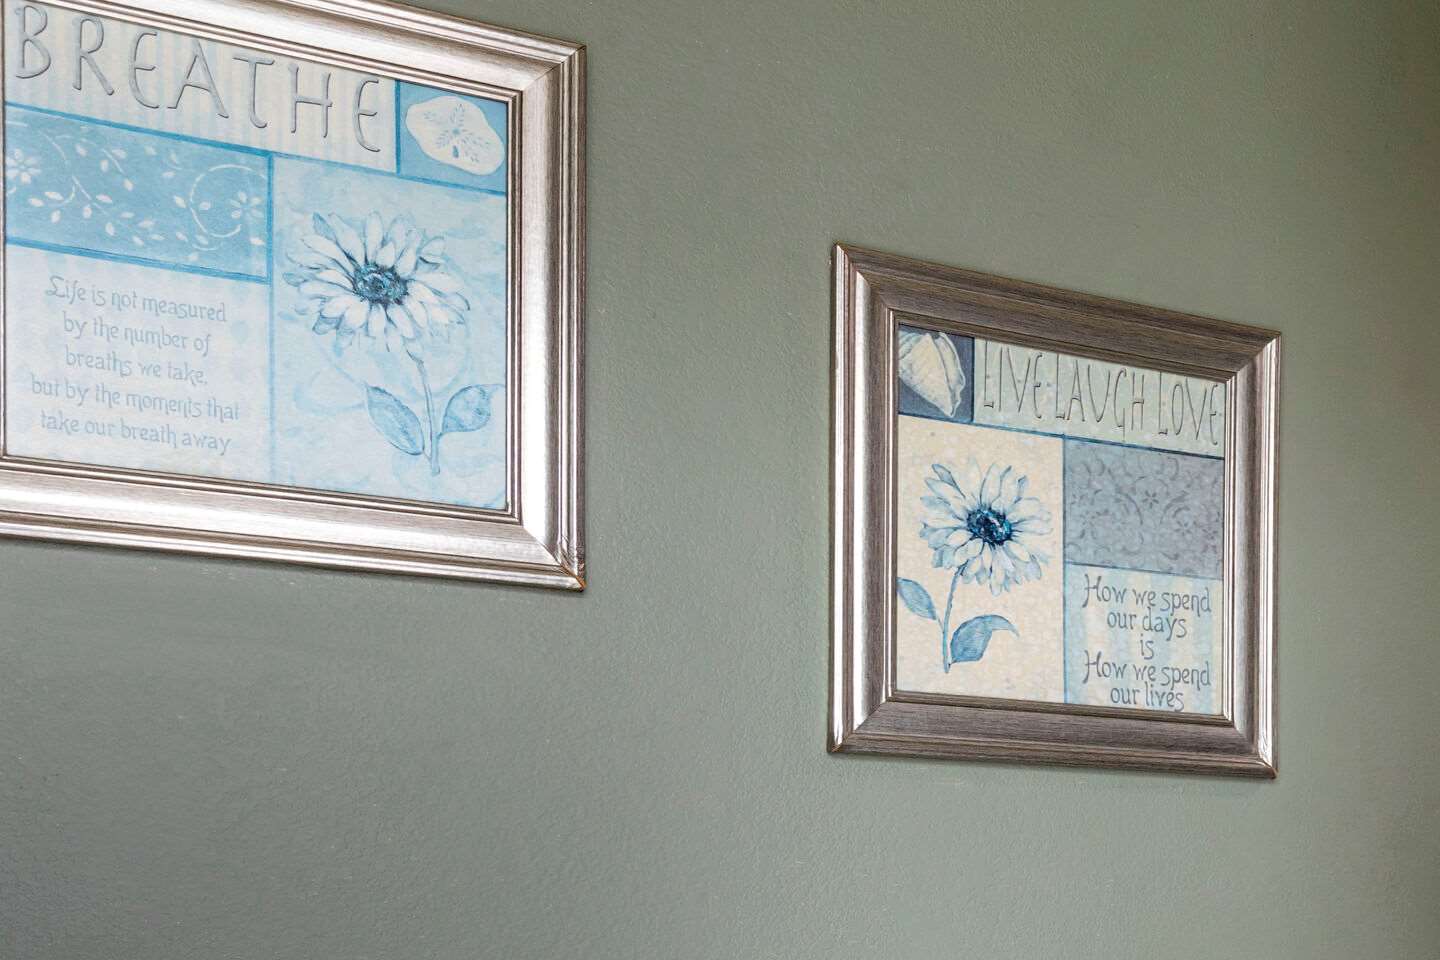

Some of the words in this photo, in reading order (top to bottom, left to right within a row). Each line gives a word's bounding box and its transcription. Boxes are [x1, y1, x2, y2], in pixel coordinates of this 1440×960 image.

[15, 6, 381, 153] BREATHE
[45, 275, 86, 304] Life
[92, 285, 106, 307] is
[112, 291, 137, 311] not
[143, 297, 227, 322] measured
[63, 311, 87, 339] by
[94, 316, 119, 343] the
[124, 326, 187, 349] number
[193, 334, 211, 358] of
[66, 344, 133, 378] breaths
[138, 362, 161, 377] we
[31, 373, 60, 397] but
[65, 378, 89, 406] by
[95, 383, 120, 409] the
[126, 392, 202, 418] moments
[207, 398, 239, 423] that
[983, 341, 1042, 419] LIVE
[1056, 353, 1145, 442] LAUGH
[1158, 371, 1218, 445] LOVE
[40, 409, 80, 435] take
[84, 420, 113, 437] our
[120, 418, 177, 448] breath
[182, 431, 231, 456] away
[1082, 574, 1127, 608] How
[1132, 588, 1157, 607] we
[1160, 587, 1211, 617] spend
[1107, 611, 1136, 629] our
[1142, 607, 1187, 641] days
[1140, 634, 1154, 660] is
[1082, 650, 1127, 684] How
[1133, 664, 1156, 682] we
[1161, 661, 1211, 691] spend
[1111, 687, 1140, 705] our
[1145, 681, 1184, 712] lives
